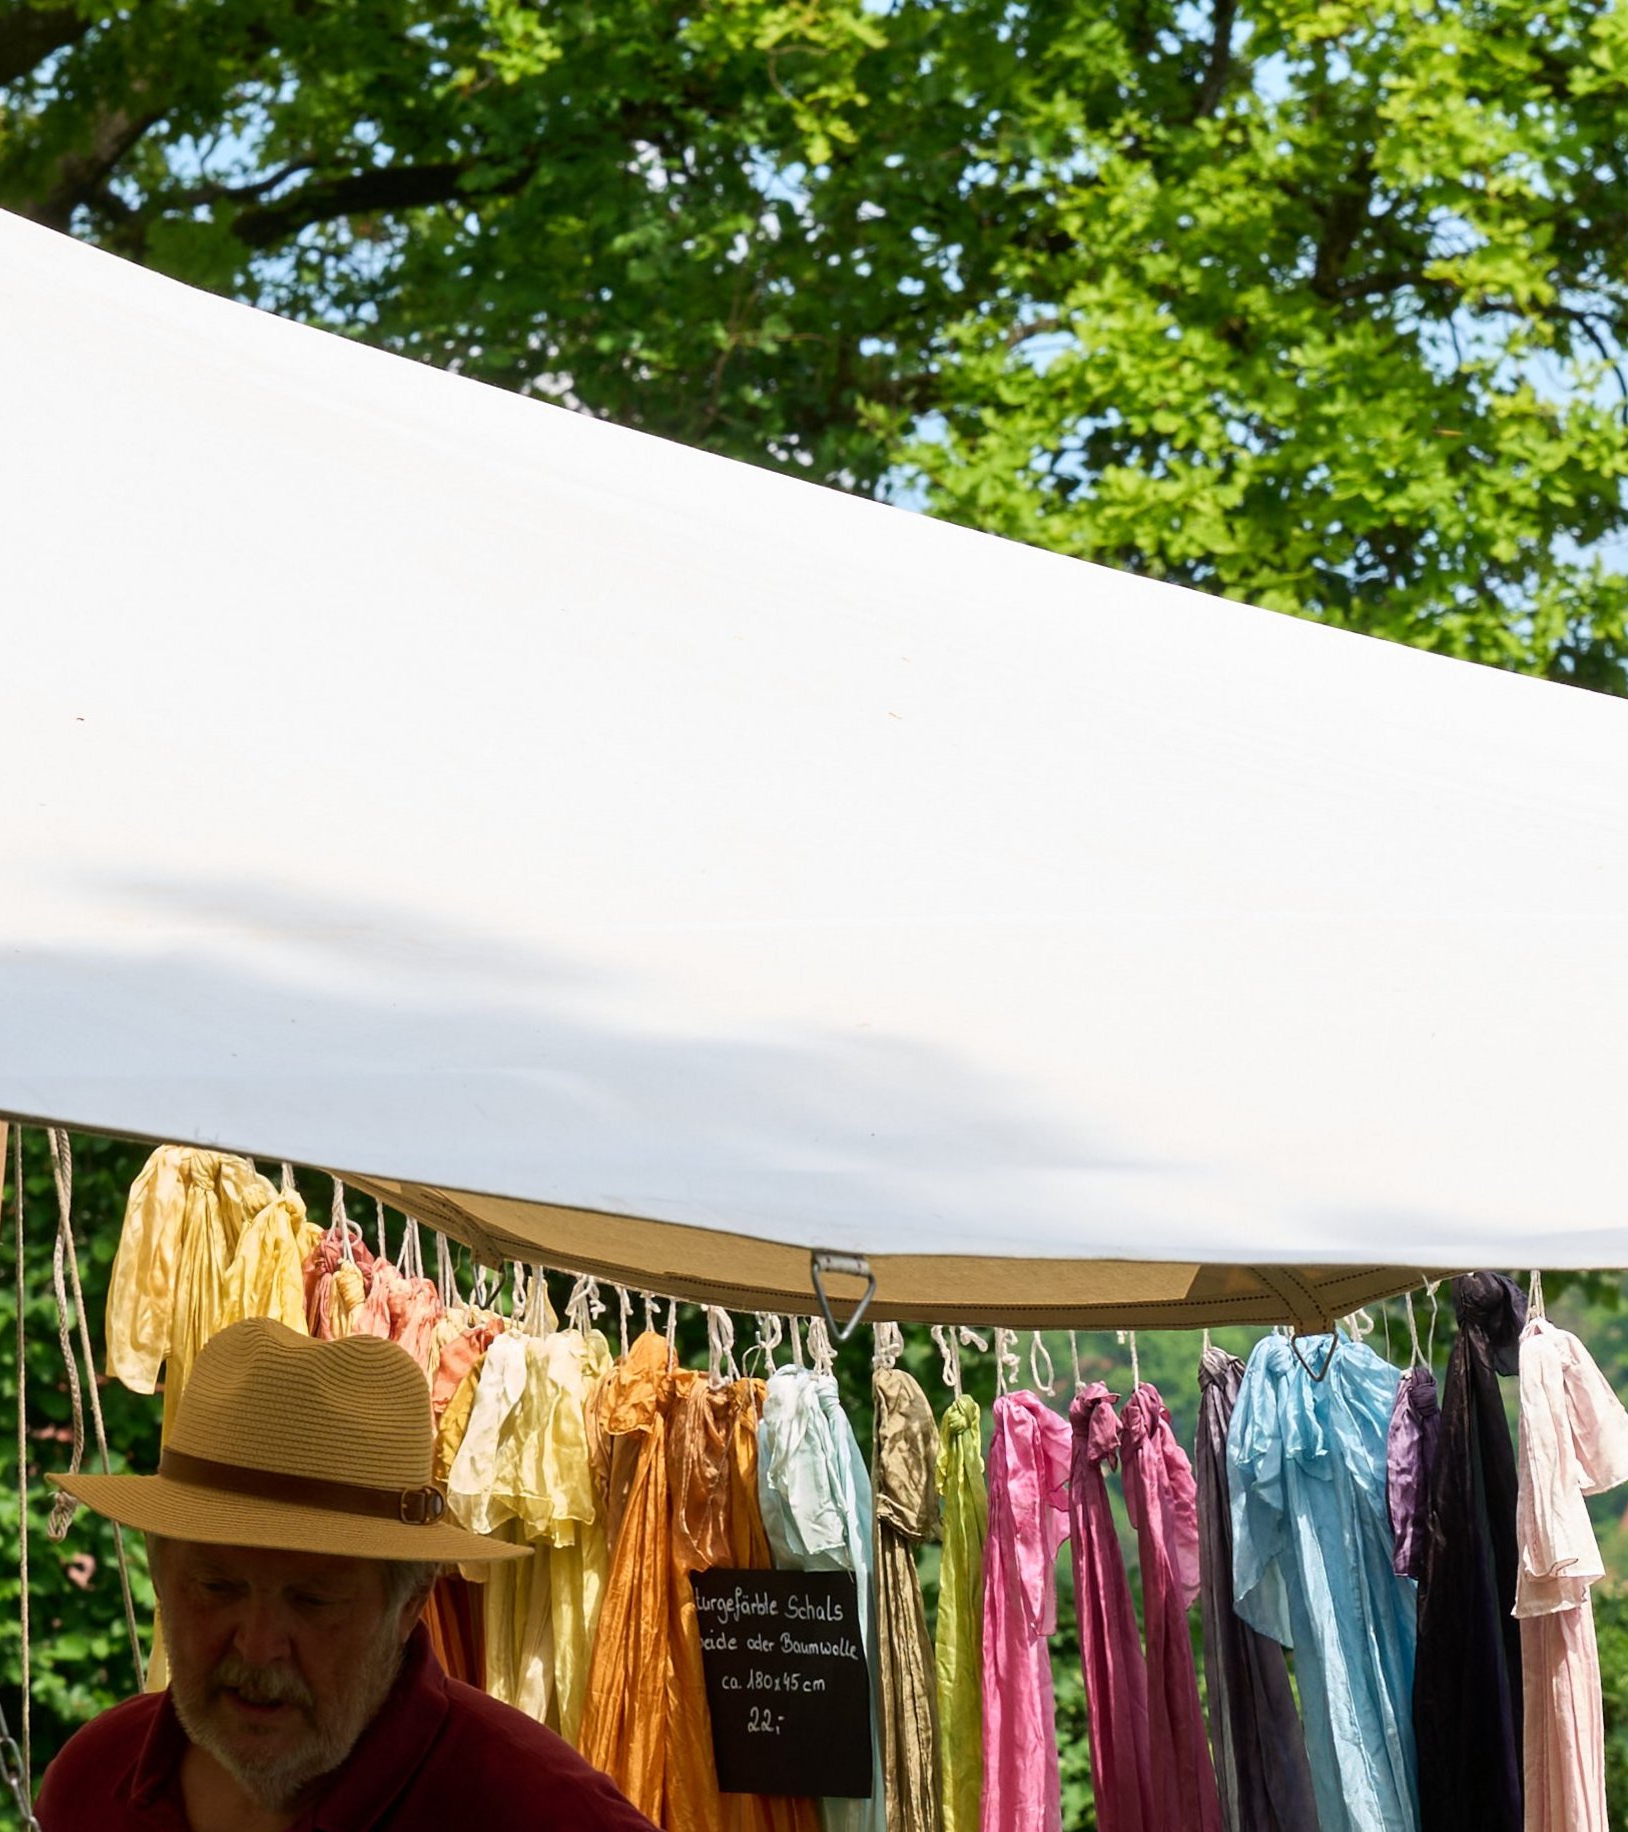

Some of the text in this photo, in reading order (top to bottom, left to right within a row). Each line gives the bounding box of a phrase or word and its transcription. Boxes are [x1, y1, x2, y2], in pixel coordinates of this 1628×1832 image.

[695, 1586, 844, 1625] turgefärbte Schals
[700, 1629, 859, 1661] eide oder Baumwolle
[722, 1675, 742, 1690] ca.
[803, 1678, 826, 1692] cm
